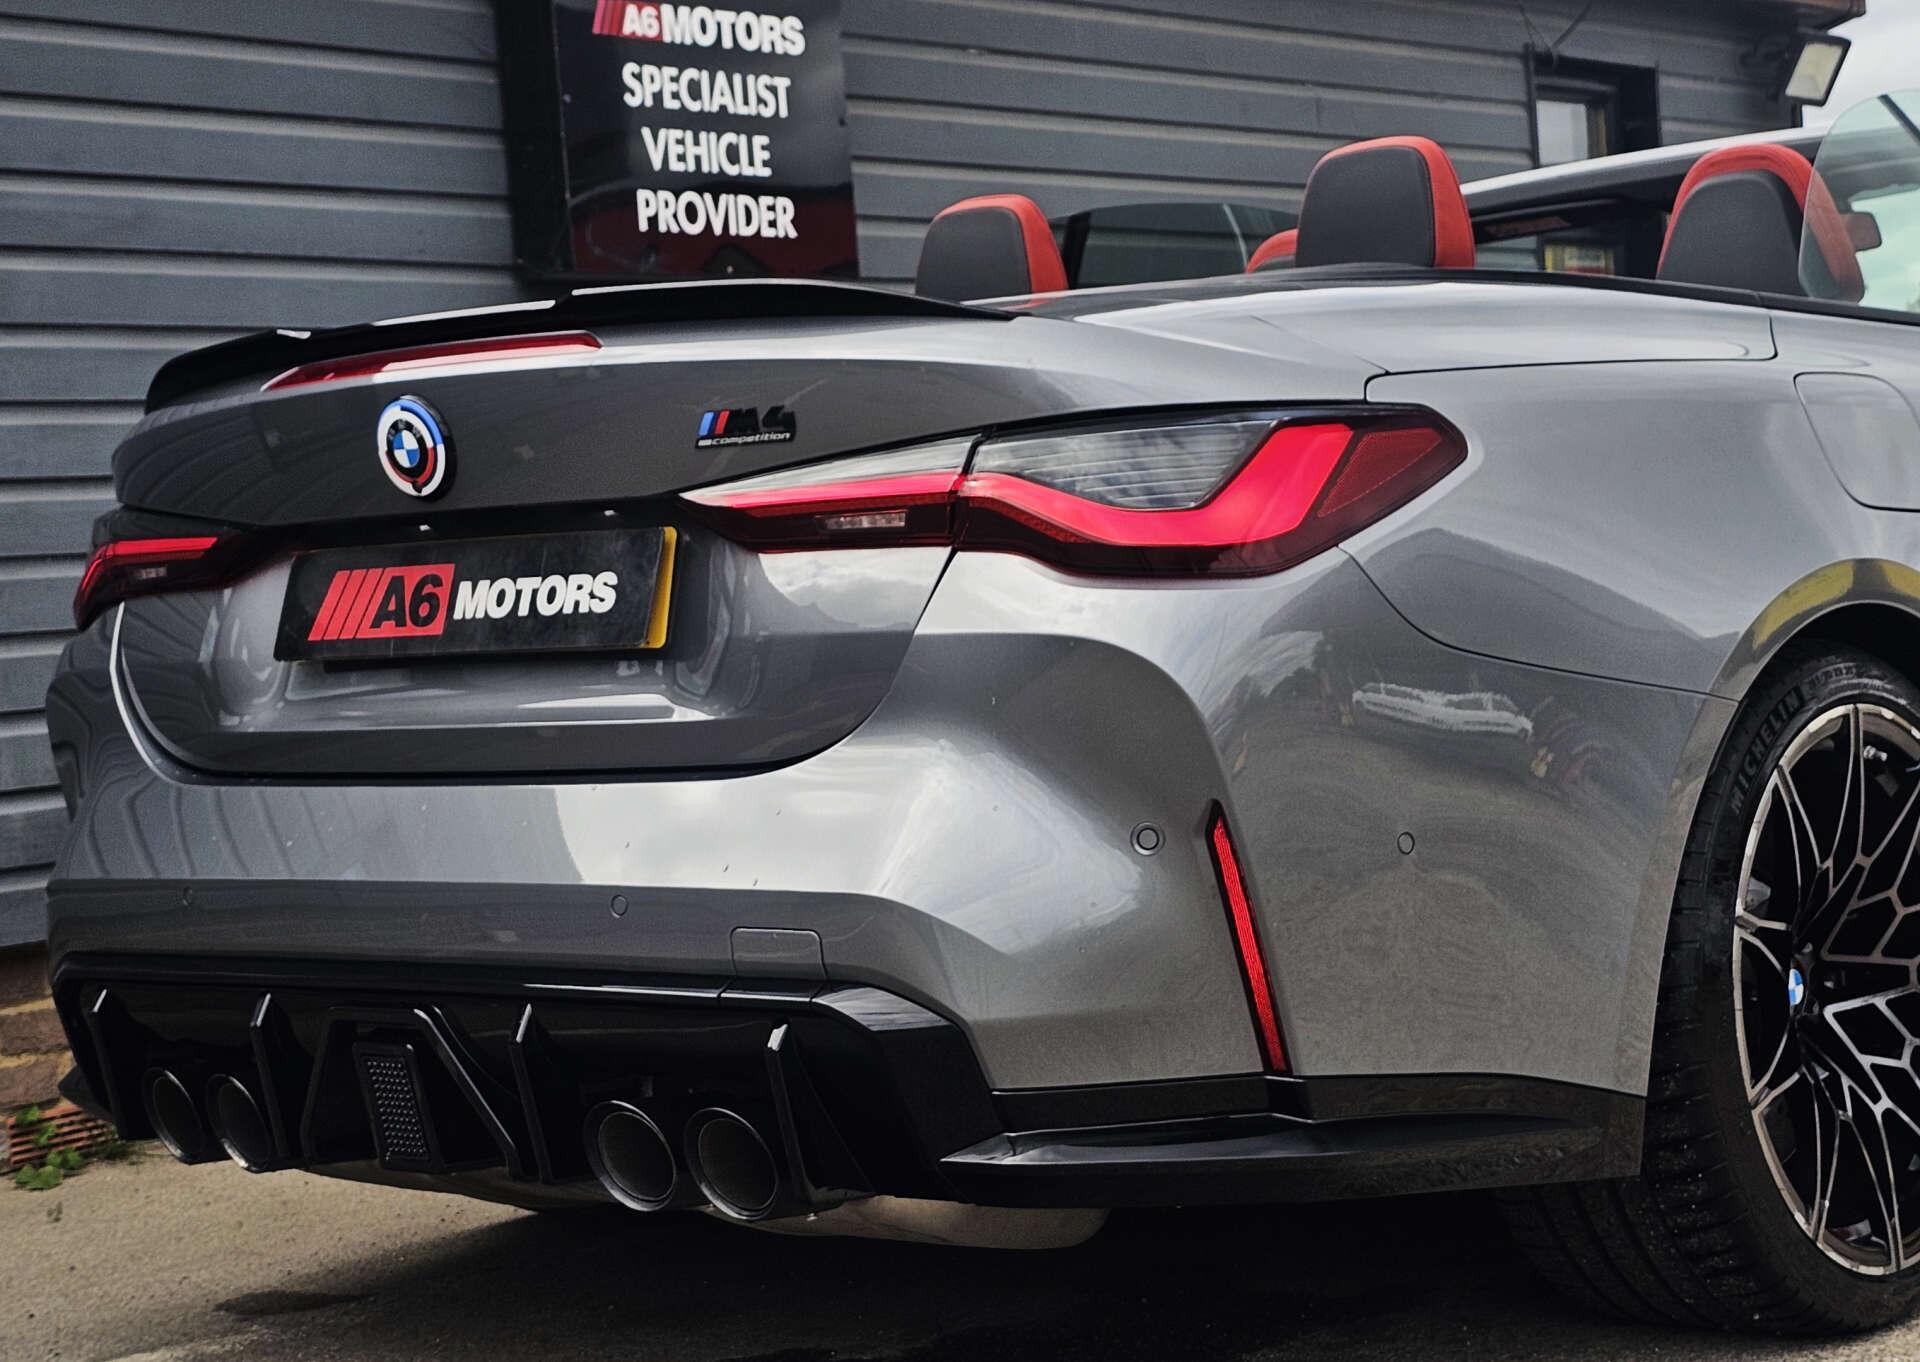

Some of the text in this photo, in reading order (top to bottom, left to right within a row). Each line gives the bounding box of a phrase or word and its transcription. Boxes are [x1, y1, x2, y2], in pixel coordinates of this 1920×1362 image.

[622, 4, 806, 56] A6 MOTORS
[621, 62, 792, 118] SPECIALIST
[640, 127, 773, 177] VEHICLE
[636, 188, 799, 239] PROVIDER
[711, 431, 791, 445] competition
[369, 570, 618, 630] A6 MOTORS
[1730, 686, 1802, 816] MICHELIN
